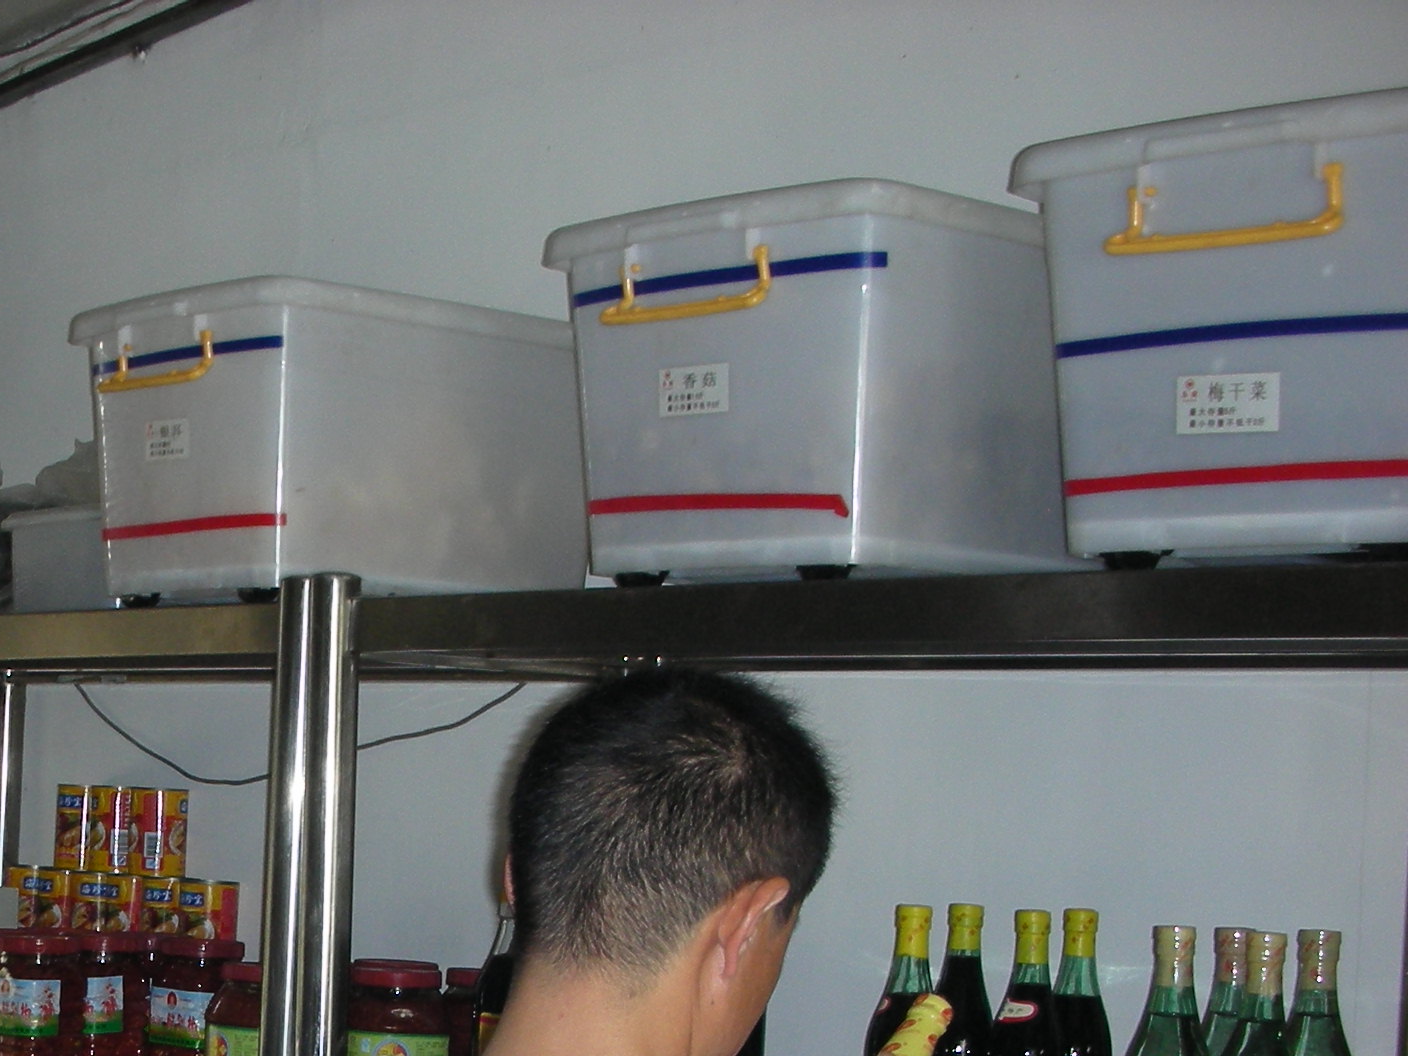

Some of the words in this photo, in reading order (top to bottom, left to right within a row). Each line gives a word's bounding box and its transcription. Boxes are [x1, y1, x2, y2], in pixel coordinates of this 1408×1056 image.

[683, 371, 717, 389] 香菇
[1208, 381, 1267, 402] 梅干菜
